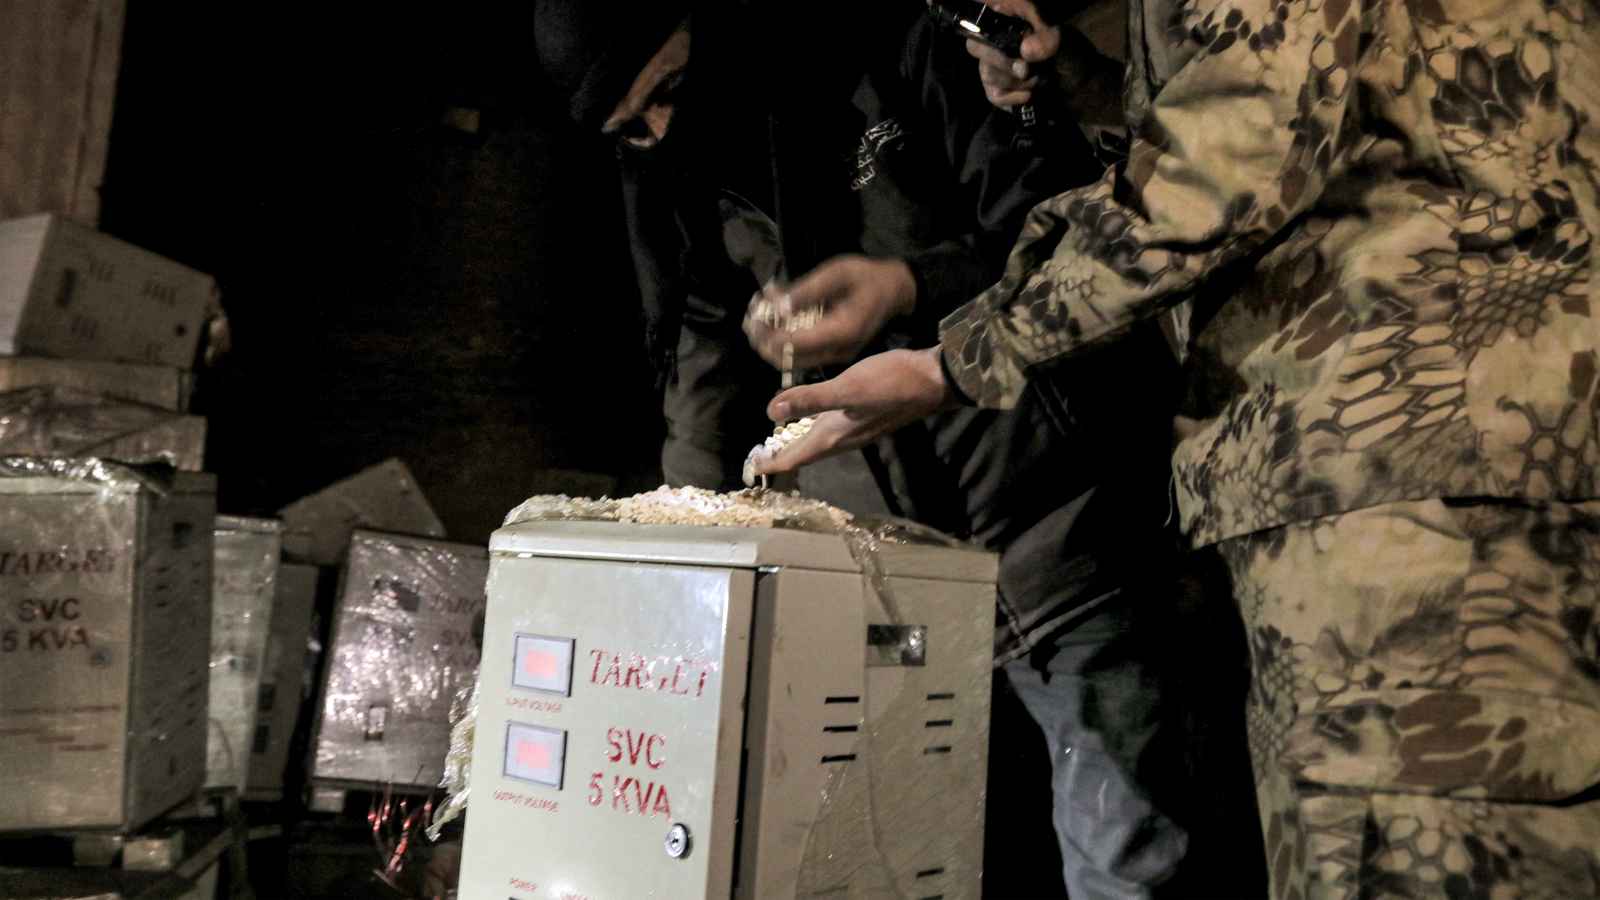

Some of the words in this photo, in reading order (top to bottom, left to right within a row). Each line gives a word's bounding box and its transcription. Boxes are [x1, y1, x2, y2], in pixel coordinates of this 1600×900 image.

[18, 598, 81, 623] SVC
[2, 630, 18, 653] 5
[28, 627, 91, 651] KVA
[590, 649, 707, 697] TARGET
[606, 726, 666, 770] SVC
[587, 772, 605, 807] 5
[612, 773, 673, 823] KVA
